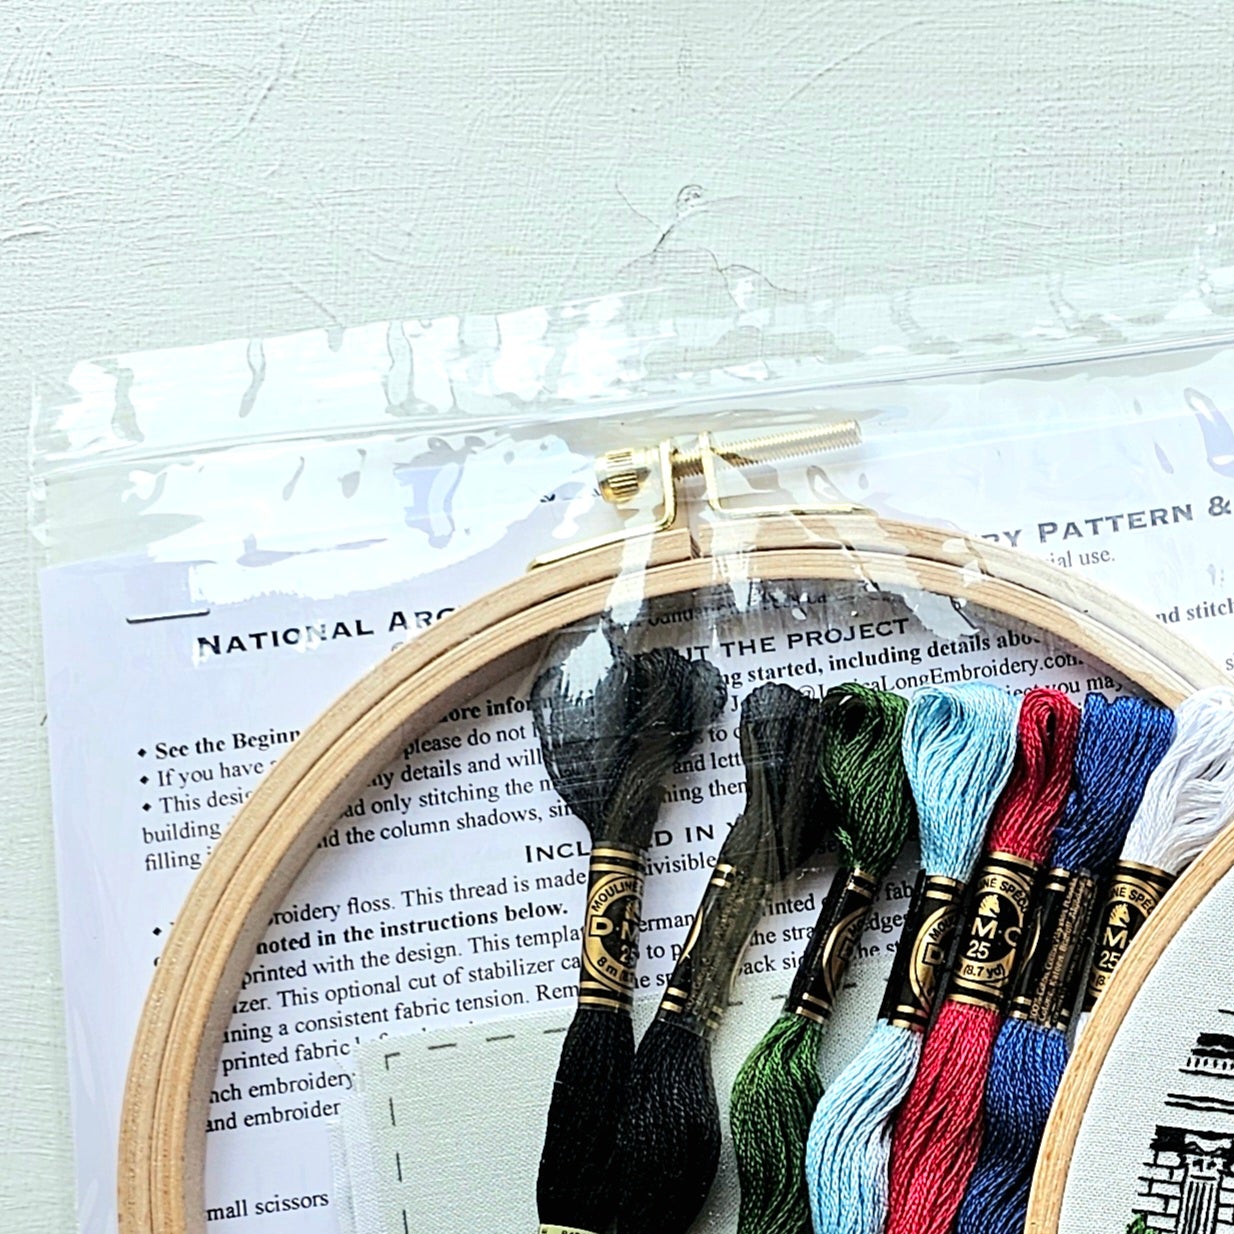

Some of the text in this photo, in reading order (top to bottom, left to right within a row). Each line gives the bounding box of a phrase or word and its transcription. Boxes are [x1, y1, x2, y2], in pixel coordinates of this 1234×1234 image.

[197, 620, 374, 656] NATIONAL
[1038, 503, 1193, 543] PATTERN
[1208, 496, 1232, 518] &
[1080, 549, 1116, 568] use.
[720, 636, 776, 657] THE
[787, 618, 909, 649] PROJECT
[155, 742, 189, 760] See
[195, 736, 225, 755] the
[748, 658, 823, 683] started,
[829, 645, 922, 671] including
[927, 633, 991, 659] details
[158, 770, 175, 787] If
[178, 767, 214, 789] you
[220, 760, 264, 779] have
[403, 733, 462, 759] please
[467, 729, 491, 746] do
[497, 725, 526, 743] not
[159, 796, 201, 814] This
[401, 759, 462, 783] details
[468, 753, 501, 774] and
[507, 748, 542, 769] will
[709, 729, 728, 743] to
[142, 822, 221, 845] building
[371, 793, 411, 815] only
[419, 783, 500, 808] stitching
[505, 776, 534, 796] the
[673, 753, 706, 775] and
[145, 851, 202, 872] filling
[346, 826, 375, 845] the
[380, 820, 450, 841] column
[456, 808, 543, 832] shadows,
[685, 824, 714, 843] IN
[347, 896, 396, 916] floss.
[401, 886, 444, 907] This
[449, 877, 508, 901] thread
[514, 875, 530, 893] is
[536, 869, 587, 891] made
[256, 902, 569, 955] noted in the instructions below.
[313, 953, 355, 975] with
[361, 950, 390, 969] the
[395, 943, 462, 964] design.
[468, 934, 511, 954] This
[966, 939, 991, 959] 25
[277, 987, 320, 1008] This
[325, 975, 402, 1005] optional
[408, 972, 437, 991] cut
[443, 966, 465, 985] of
[468, 955, 554, 983] stabilizer
[646, 944, 666, 960] to
[279, 1023, 290, 1037] a
[295, 1008, 390, 1034] consistent
[395, 994, 450, 1021] fabric
[456, 985, 530, 1013] tension.
[222, 1039, 350, 1077] printed fabric
[255, 1192, 330, 1216] scissors
